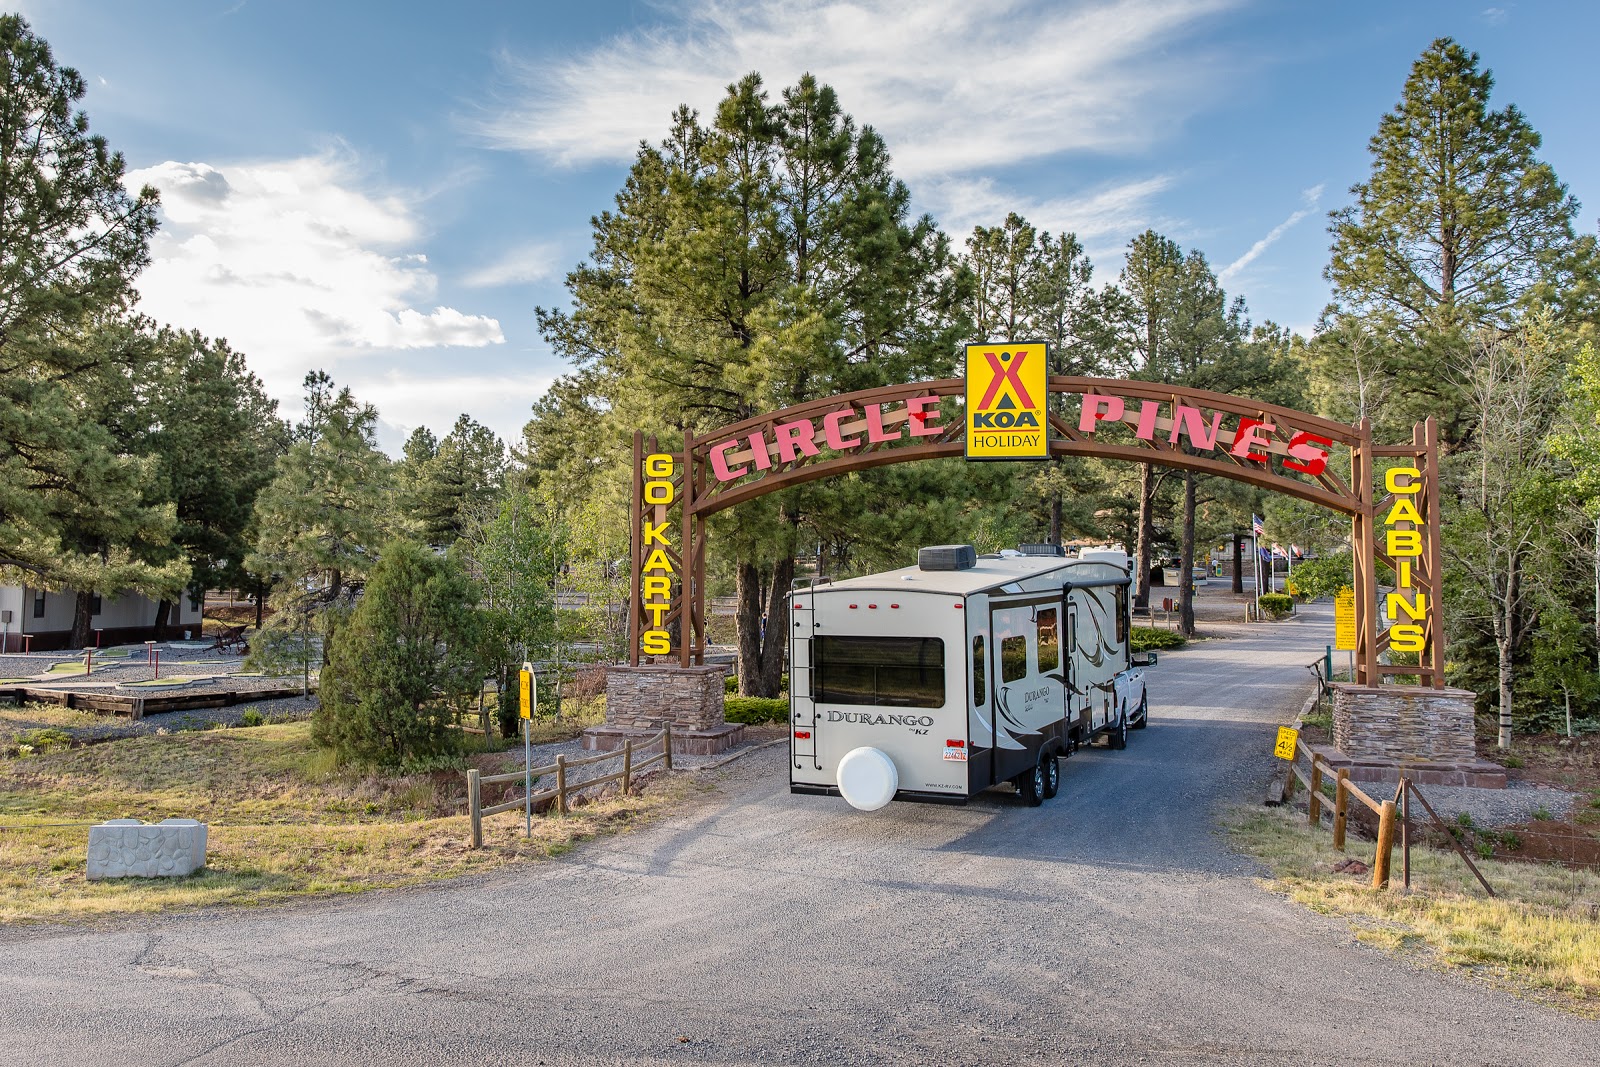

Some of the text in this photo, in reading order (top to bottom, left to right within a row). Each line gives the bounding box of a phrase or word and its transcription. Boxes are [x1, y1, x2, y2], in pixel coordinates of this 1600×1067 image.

[709, 393, 1333, 482] CIRCLE PINES
[973, 411, 1040, 429] KOA
[973, 434, 1041, 448] HOLIDAY
[643, 453, 675, 656] GO KARTS
[1384, 467, 1427, 652] CABINS
[827, 710, 934, 727] DURANGO
